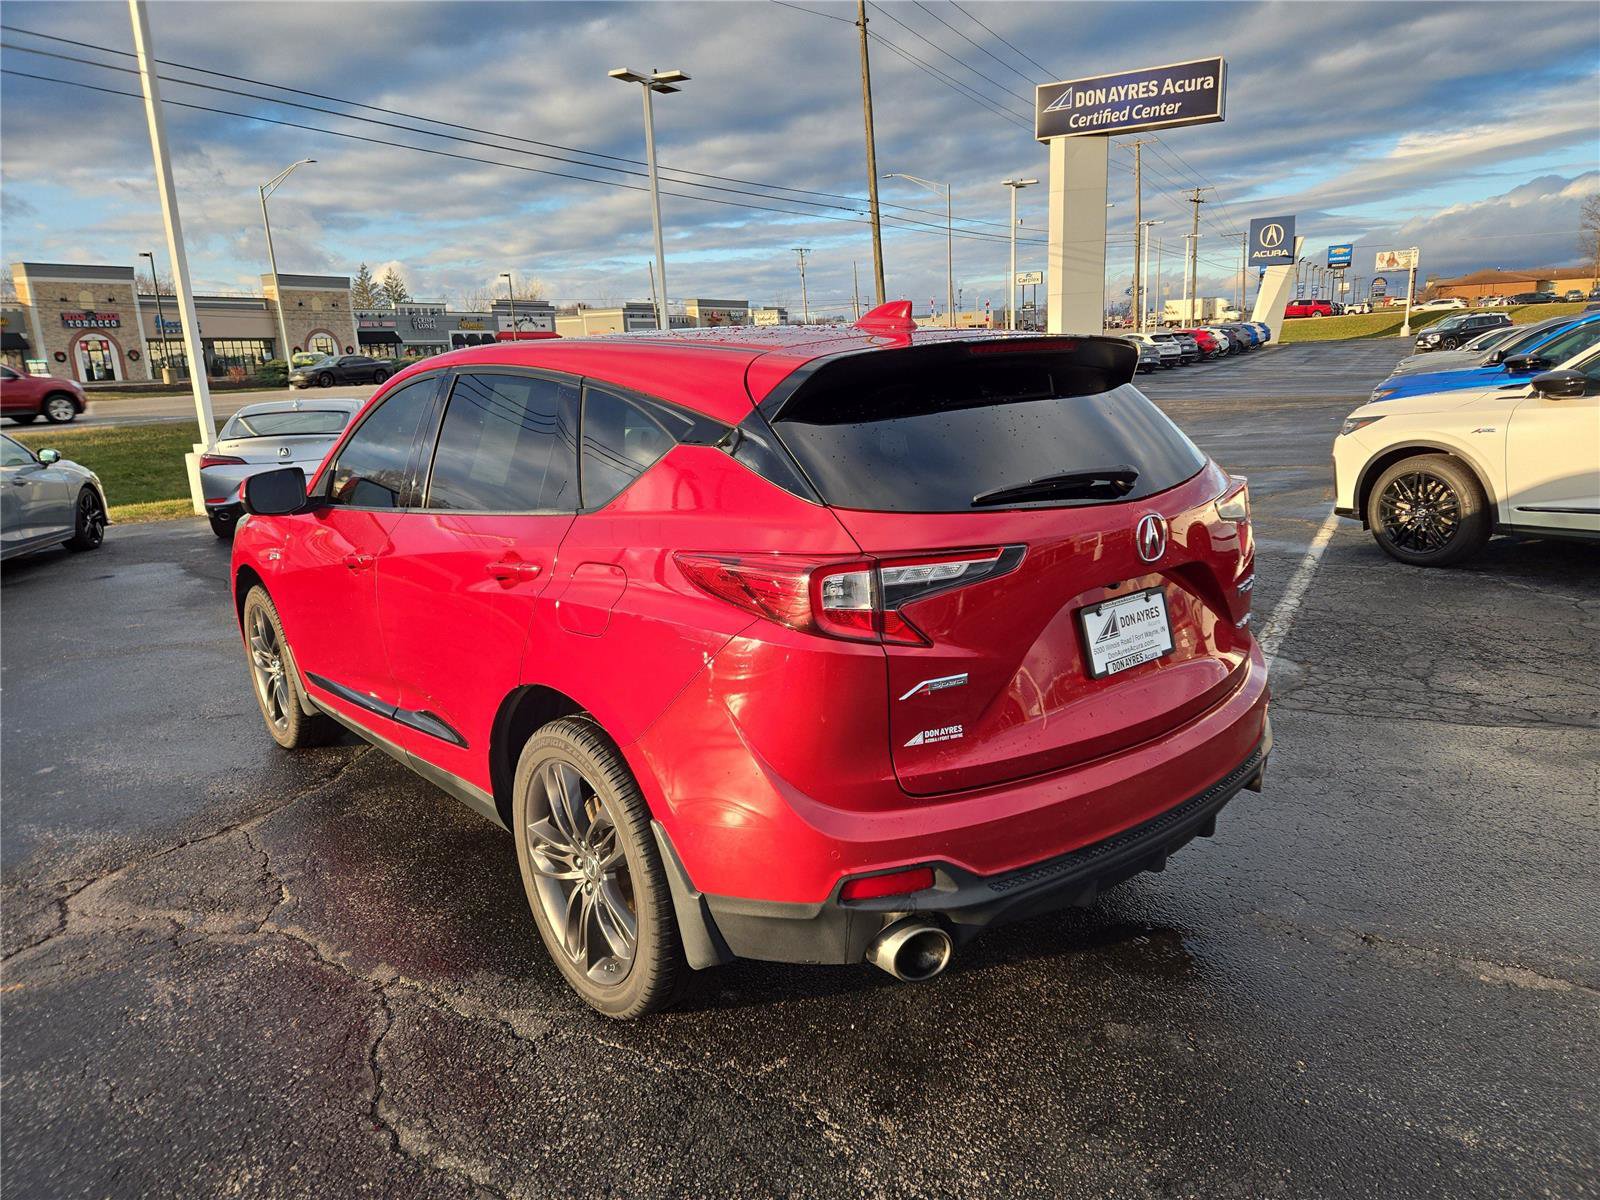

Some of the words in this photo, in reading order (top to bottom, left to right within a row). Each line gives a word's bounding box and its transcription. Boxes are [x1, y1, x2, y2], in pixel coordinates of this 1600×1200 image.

[1075, 88, 1106, 108] DON
[1108, 80, 1159, 103] AYRES
[1161, 75, 1215, 96] Acura
[1069, 105, 1130, 129] Certified
[1132, 101, 1182, 120] Center
[1252, 249, 1289, 258] ACURA
[67, 319, 118, 328] TOBACCO
[1120, 613, 1136, 628] DON
[1136, 606, 1160, 623] AYRES
[1135, 633, 1144, 641] Fort
[1112, 660, 1125, 672] DON
[1125, 653, 1144, 668] AYRES
[1144, 651, 1158, 661] Acura
[924, 729, 940, 738] DON
[939, 724, 963, 736] AYRES
